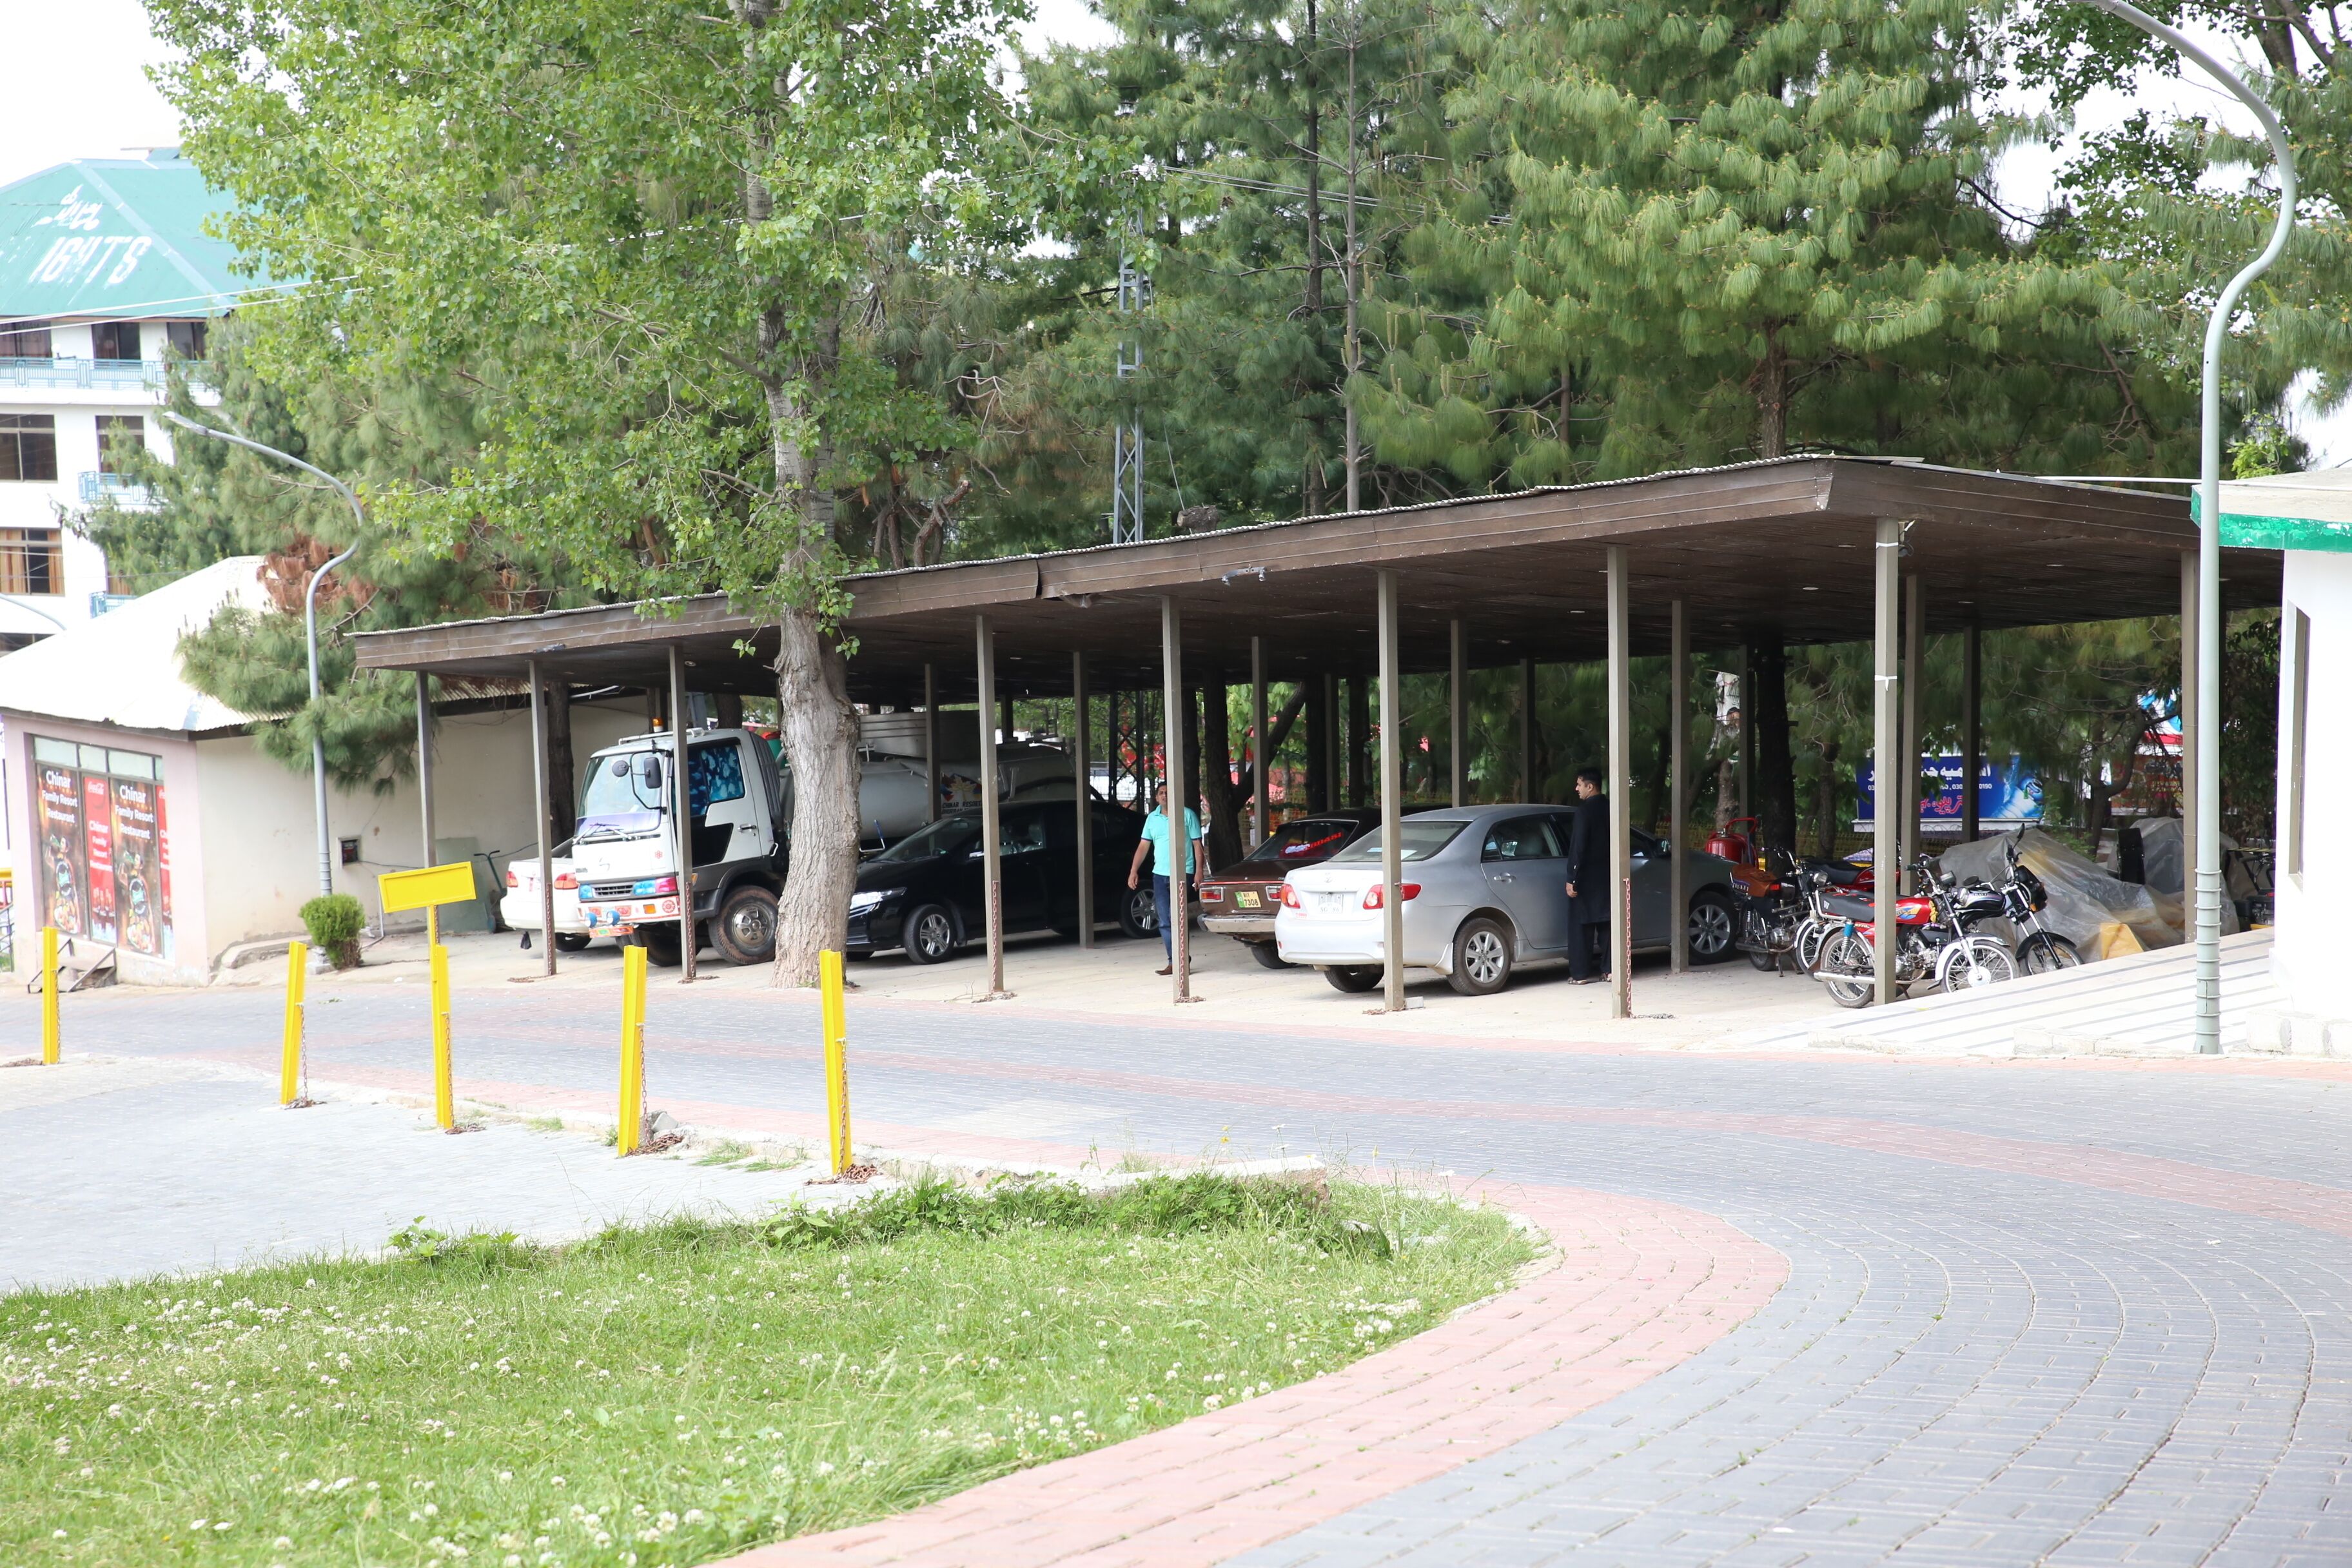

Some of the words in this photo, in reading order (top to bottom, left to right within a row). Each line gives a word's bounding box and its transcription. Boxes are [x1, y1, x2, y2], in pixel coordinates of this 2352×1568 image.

[46, 770, 72, 789] Chinar
[41, 790, 59, 805] Family
[59, 793, 78, 807] Resort
[119, 785, 147, 803] Chinar
[47, 808, 75, 823] Restaurant
[115, 805, 133, 820] Family
[134, 808, 154, 823] Resort
[88, 820, 109, 834] Chinar
[120, 823, 151, 839] Restaurant
